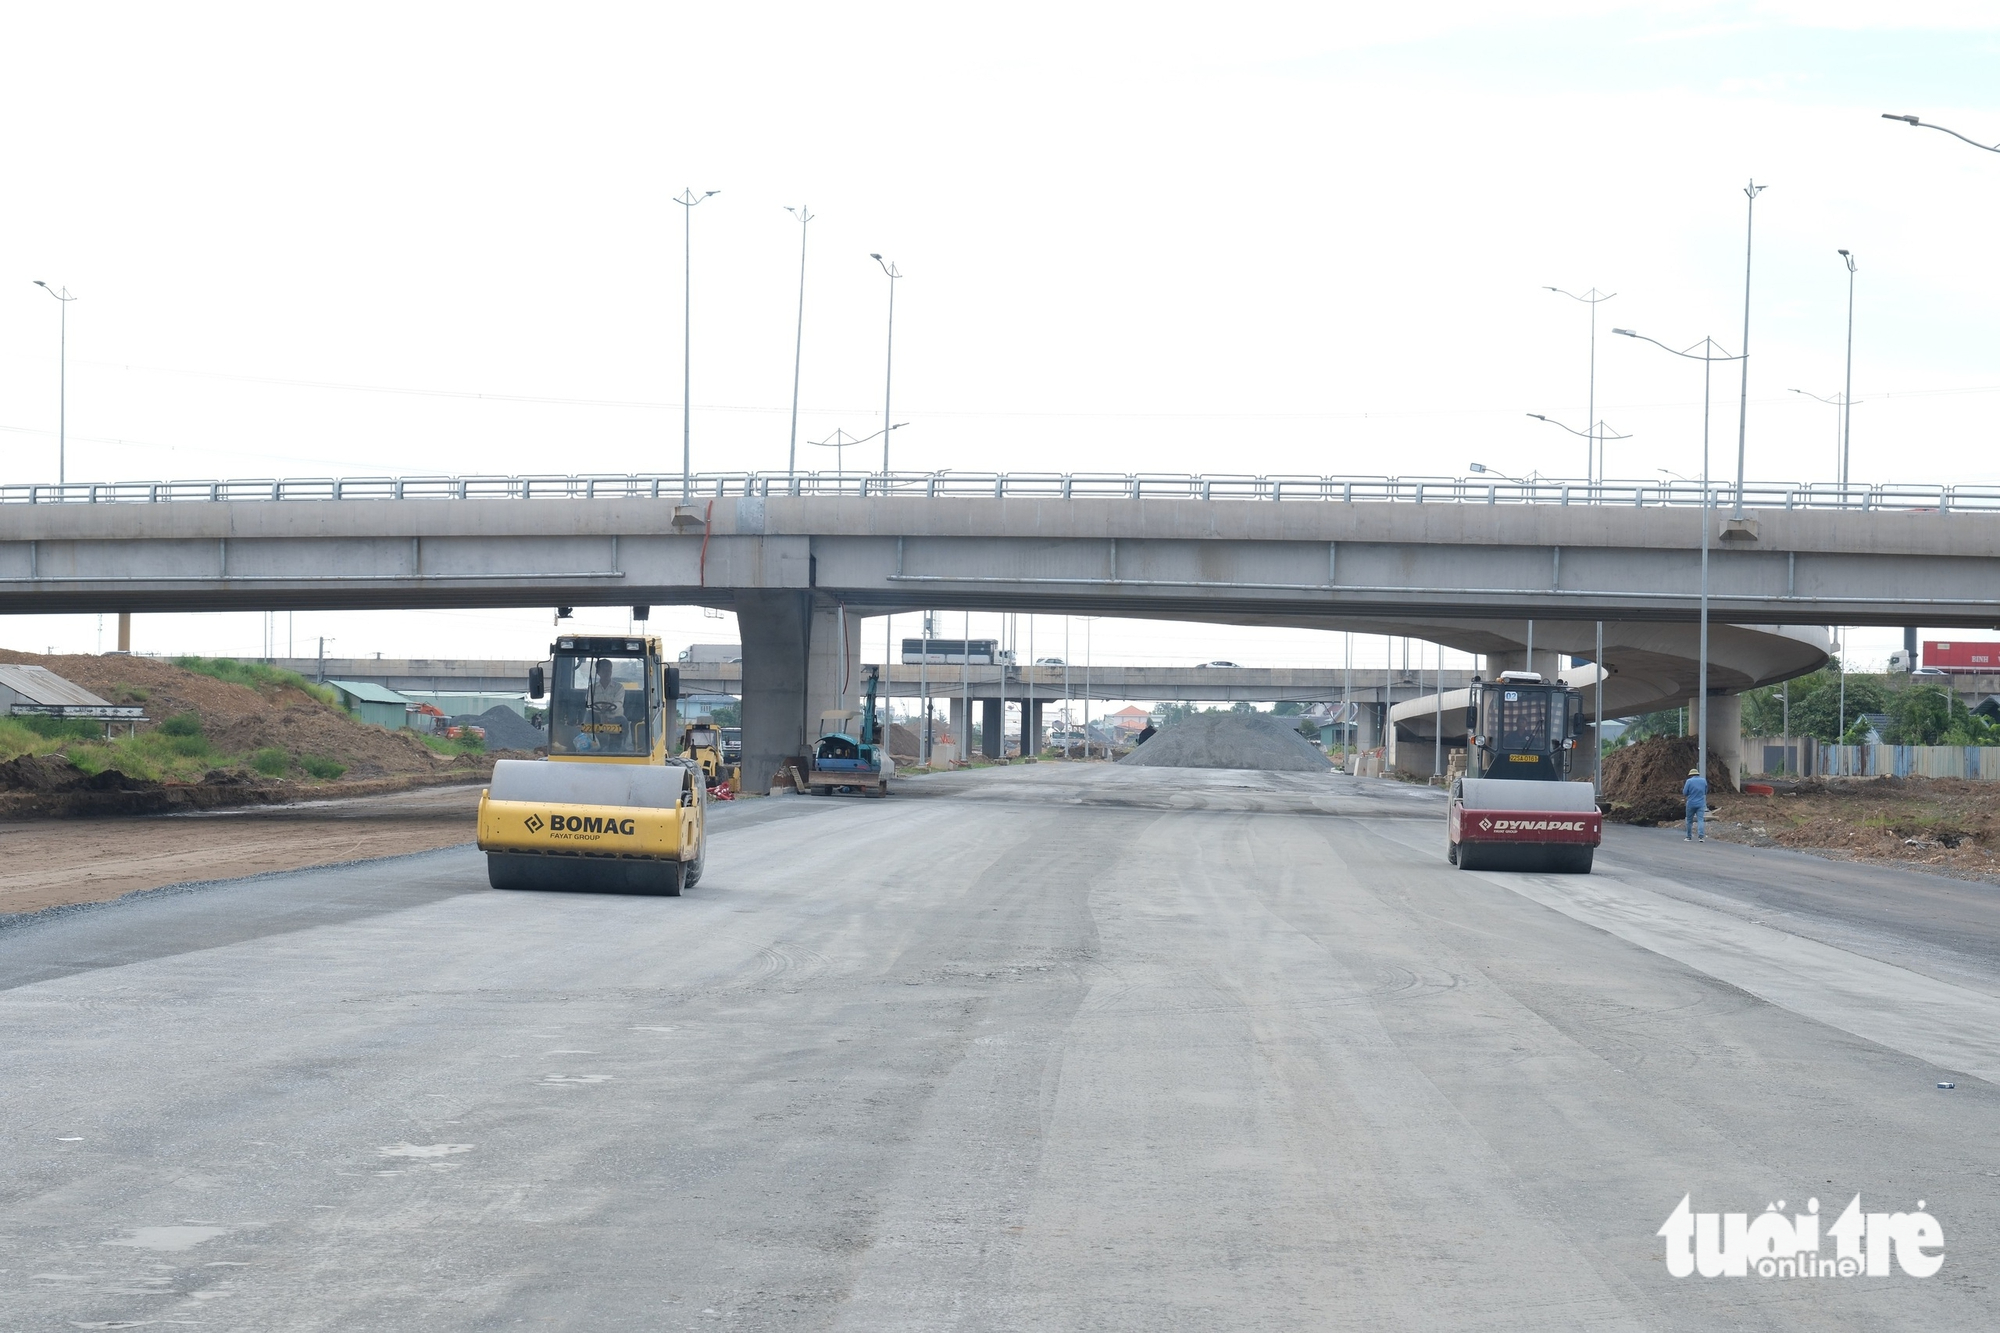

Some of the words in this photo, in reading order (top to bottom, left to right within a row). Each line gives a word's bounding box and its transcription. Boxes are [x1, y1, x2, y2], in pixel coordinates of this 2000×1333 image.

[1506, 692, 1516, 700] 02
[550, 815, 634, 835] BOMAG
[1494, 820, 1585, 831] DYNAPAC
